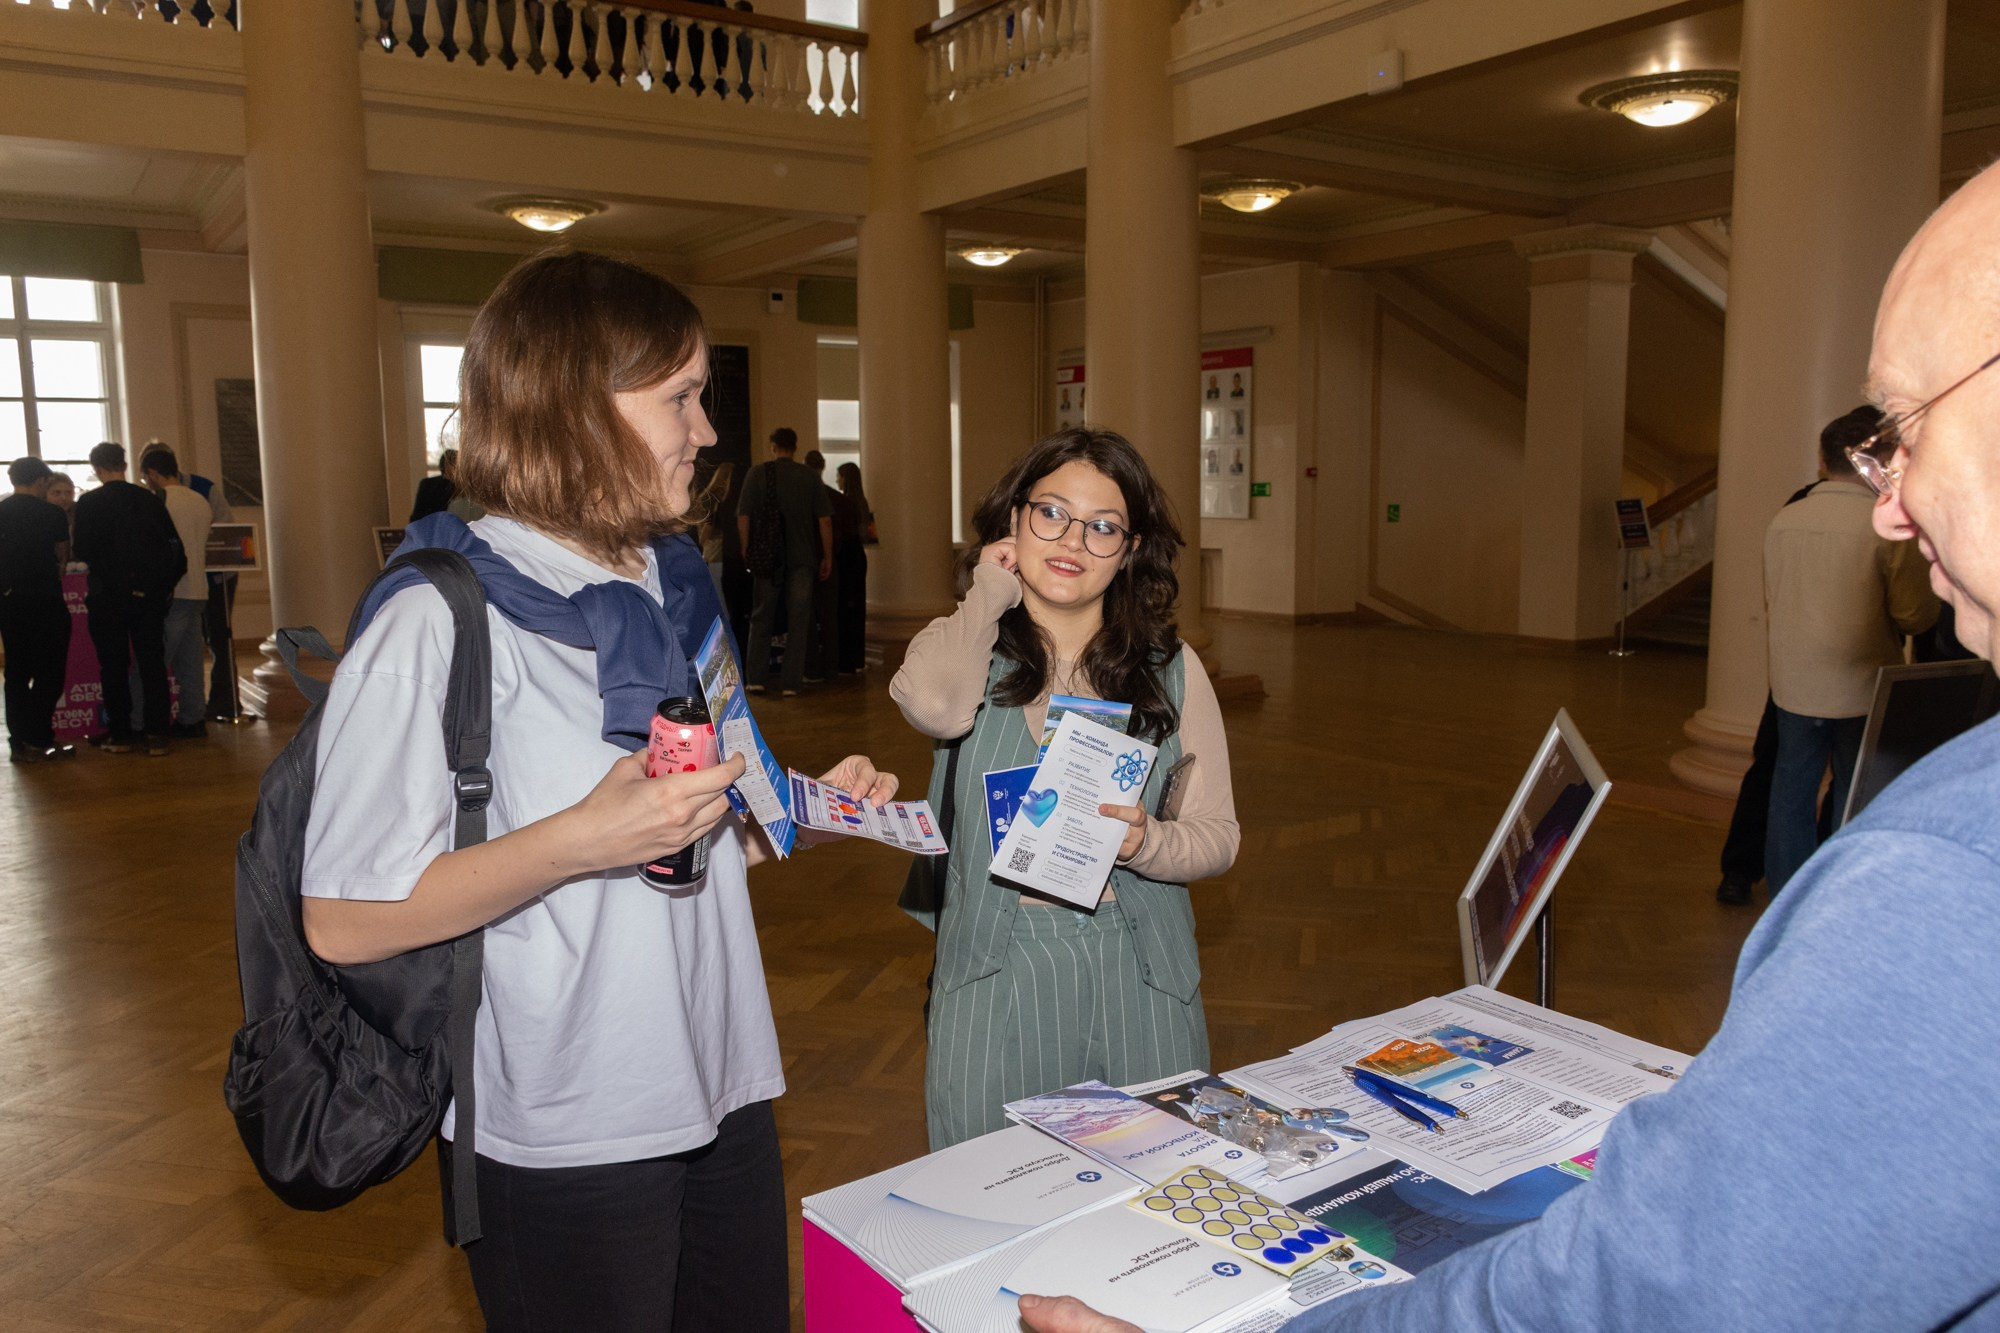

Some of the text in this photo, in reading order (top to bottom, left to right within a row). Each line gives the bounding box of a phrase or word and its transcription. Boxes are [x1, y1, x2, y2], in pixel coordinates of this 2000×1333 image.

[1068, 736, 1115, 758] ПРОФЕССИОНАЛОВ!
[1071, 729, 1081, 737] МЫ
[1085, 735, 1109, 748] КОМАНДА
[1068, 761, 1091, 774] РАЗВИТИЕ
[1070, 783, 1099, 799] ТЕХНОЛОГИИ
[1066, 816, 1084, 826] ЗАБОТА
[1055, 843, 1098, 864] ТРУДОУСТРОЙСТВО
[1056, 852, 1087, 866] СТАЖИРОВКА
[1391, 1041, 1408, 1052] 2026
[1413, 1044, 1434, 1054] 2026
[1122, 1130, 1200, 1161] КОЛЬСКОЙ АЭС
[1192, 1134, 1209, 1142] НА
[1177, 1138, 1218, 1158] РАБОТА
[1006, 1153, 1064, 1175] Кольскую АЭС
[1044, 1156, 1071, 1167] Добро
[995, 1165, 1044, 1185] пожаловать
[1360, 1173, 1403, 1195] НАШЕЙ
[1410, 1173, 1433, 1184] ЭС:
[1130, 1236, 1192, 1264] Кольскую АЭС
[1108, 1241, 1200, 1283] Добро пожаловать на
